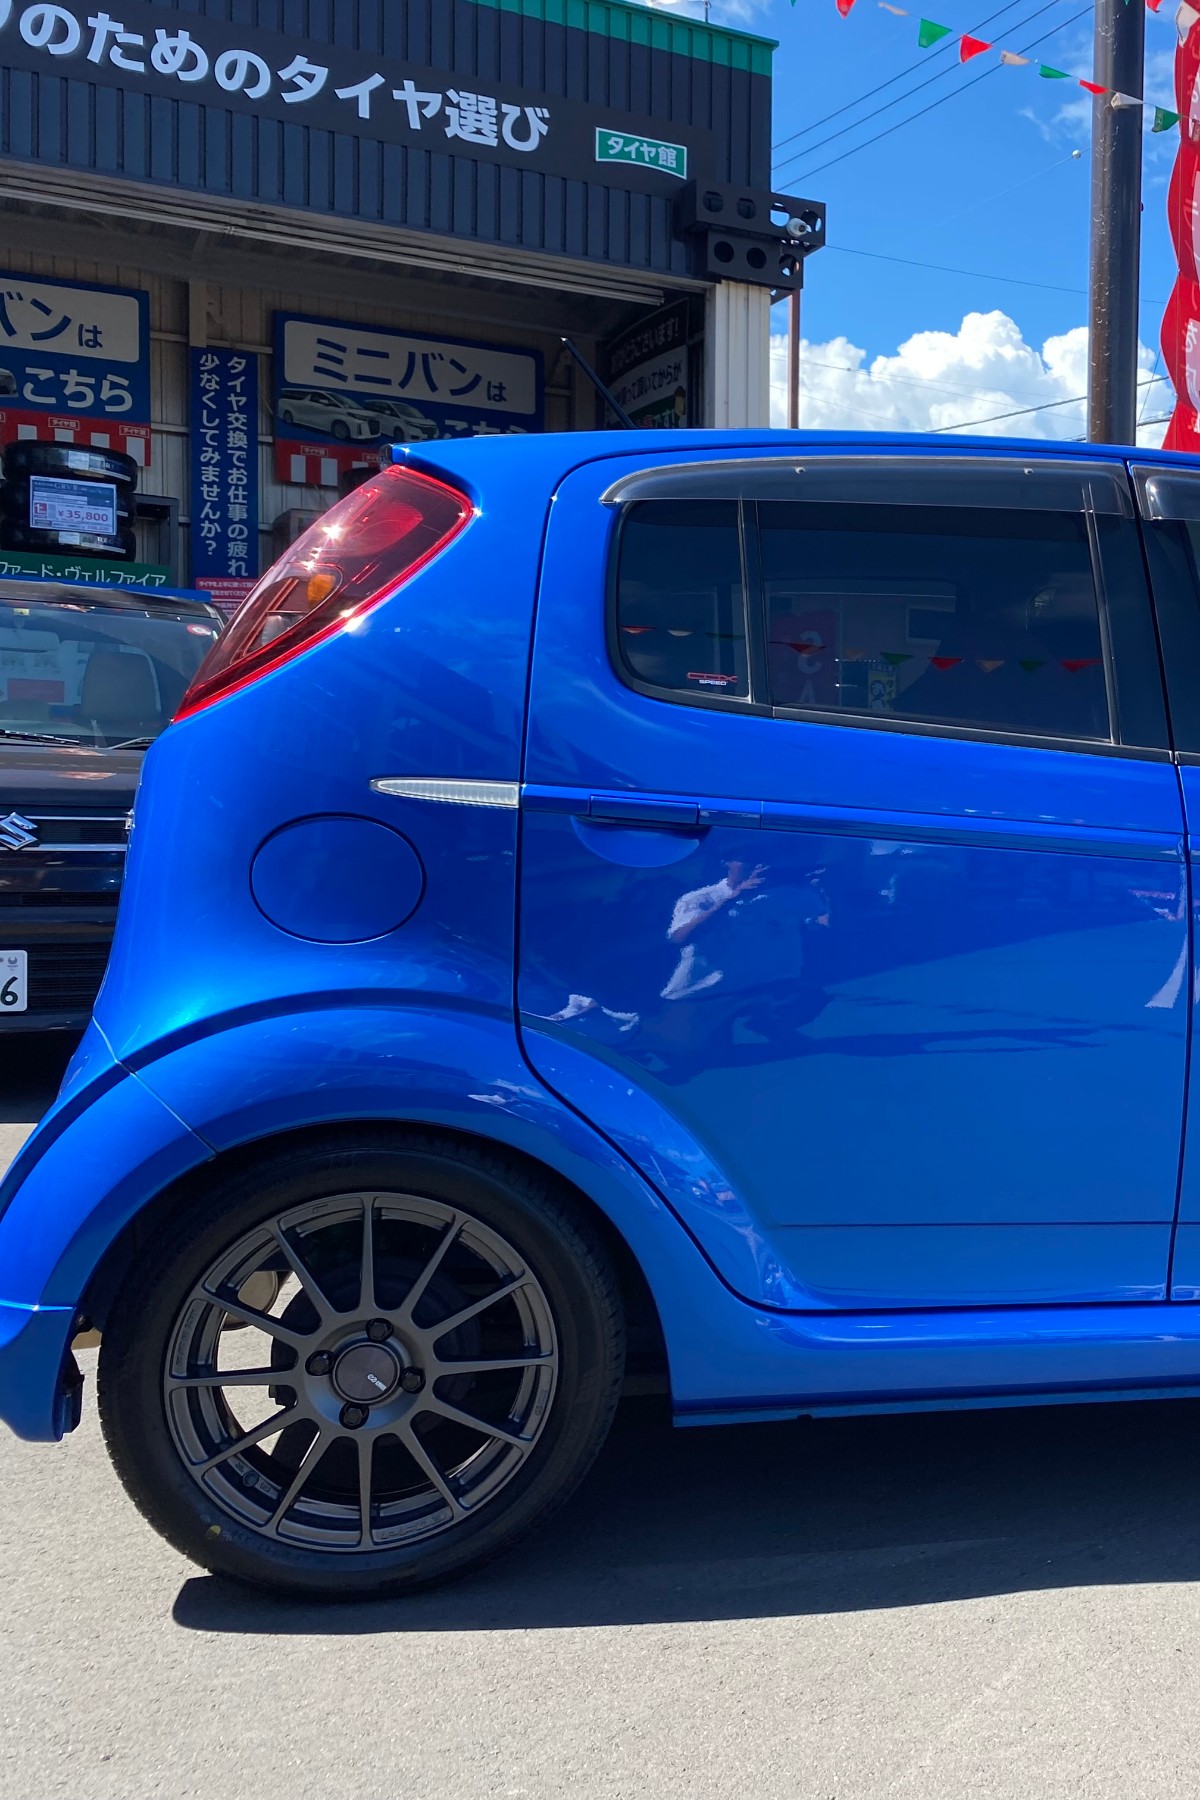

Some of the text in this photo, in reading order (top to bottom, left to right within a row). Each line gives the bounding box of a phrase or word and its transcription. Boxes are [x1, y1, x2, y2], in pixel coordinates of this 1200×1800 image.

[0, 0, 550, 152] のためのタイヤ選び
[606, 136, 678, 170] タイヤ館
[23, 366, 133, 413] こちら
[313, 337, 508, 403] ミニバンは
[199, 353, 222, 556] 少なくしてみませんか？
[687, 671, 738, 683] COX
[0, 976, 19, 1006] 6
